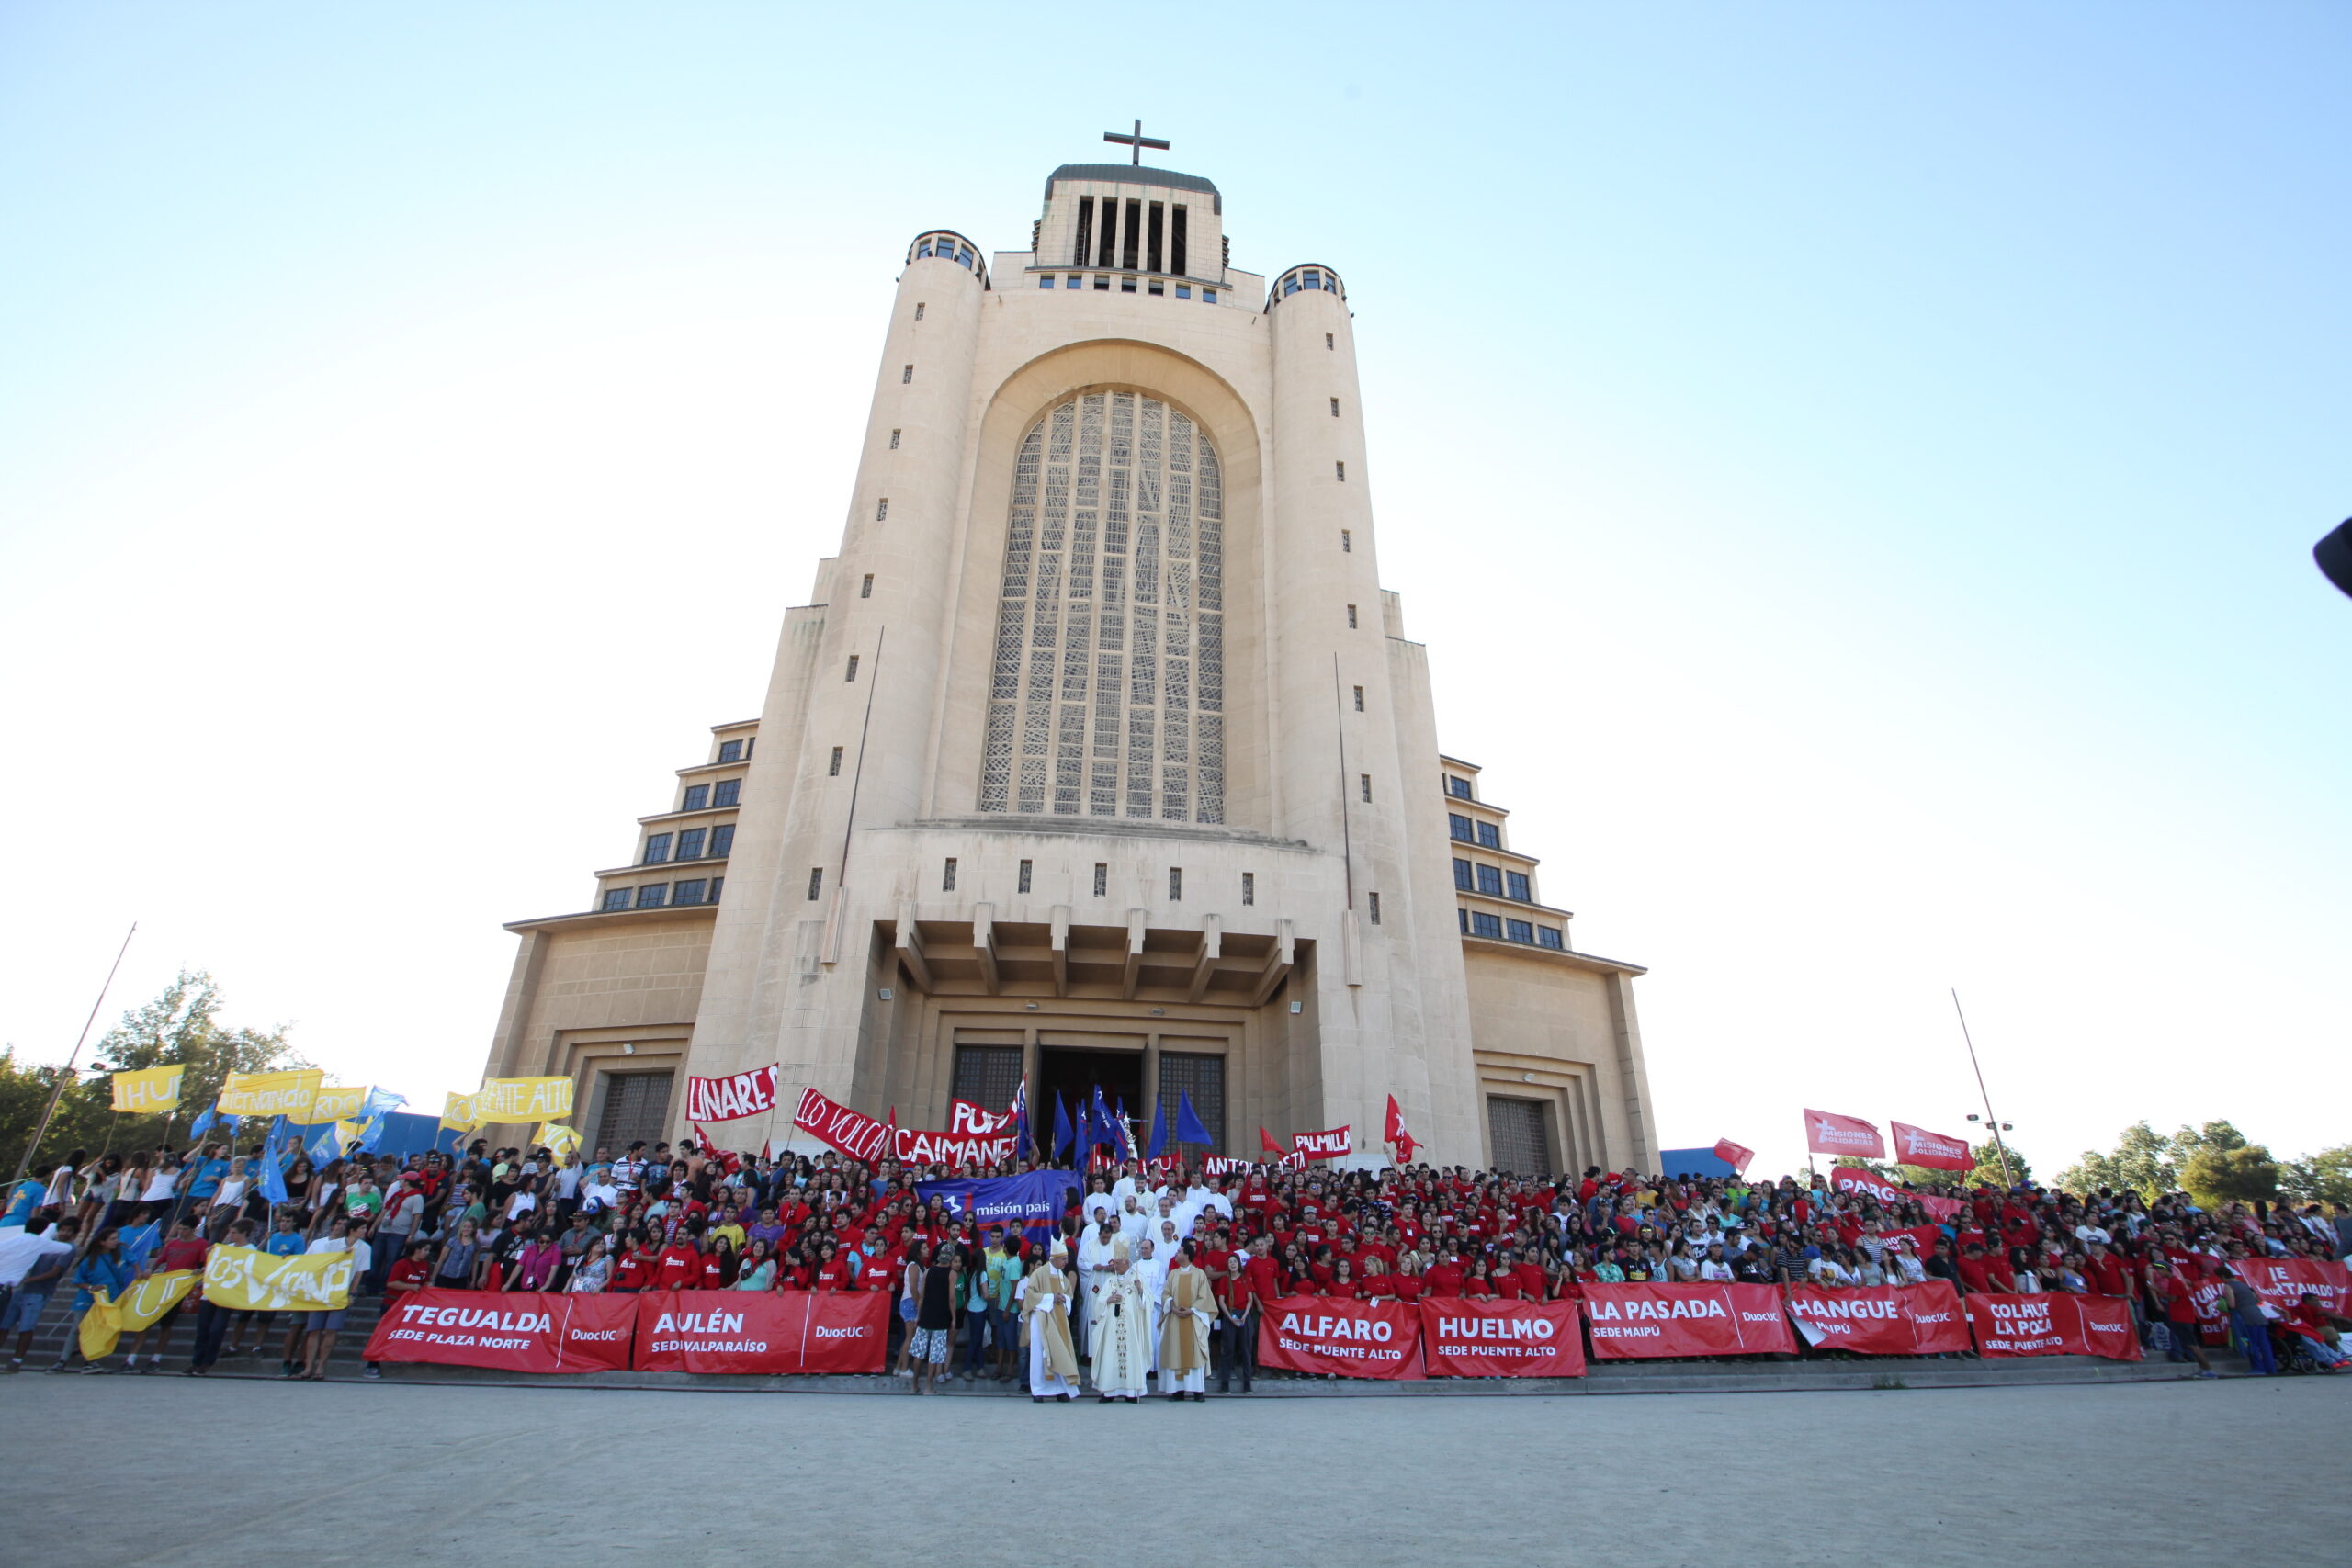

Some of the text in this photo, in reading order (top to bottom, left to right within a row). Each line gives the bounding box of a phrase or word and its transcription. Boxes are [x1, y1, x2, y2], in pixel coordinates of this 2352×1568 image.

[527, 1077, 573, 1115] ALTO
[689, 1066, 778, 1121] LINARES
[1295, 1130, 1351, 1152] PALMILLA
[1823, 1130, 1873, 1140] MISIONES
[1915, 1141, 1962, 1155] MISIONES
[1840, 1179, 1896, 1202] PARG
[976, 1201, 1050, 1217] misión país
[402, 1305, 551, 1333] TEGUALDA
[1589, 1299, 1727, 1320] LA PASADA
[1792, 1300, 1899, 1319] HANGUE
[653, 1308, 744, 1333] AULÉN
[1280, 1313, 1393, 1343] ALFARO
[1439, 1317, 1554, 1340] HUELMO
[1593, 1324, 1661, 1337] SEDE MAIPÚ
[1996, 1321, 2016, 1335] LA
[388, 1330, 531, 1350] SEDE PLAZA NORTE
[1279, 1337, 1402, 1361] SEDE PUENTE ALTO
[1985, 1340, 2012, 1349] SEDE
[1438, 1345, 1556, 1358] SEDE PUENTE ALTO
